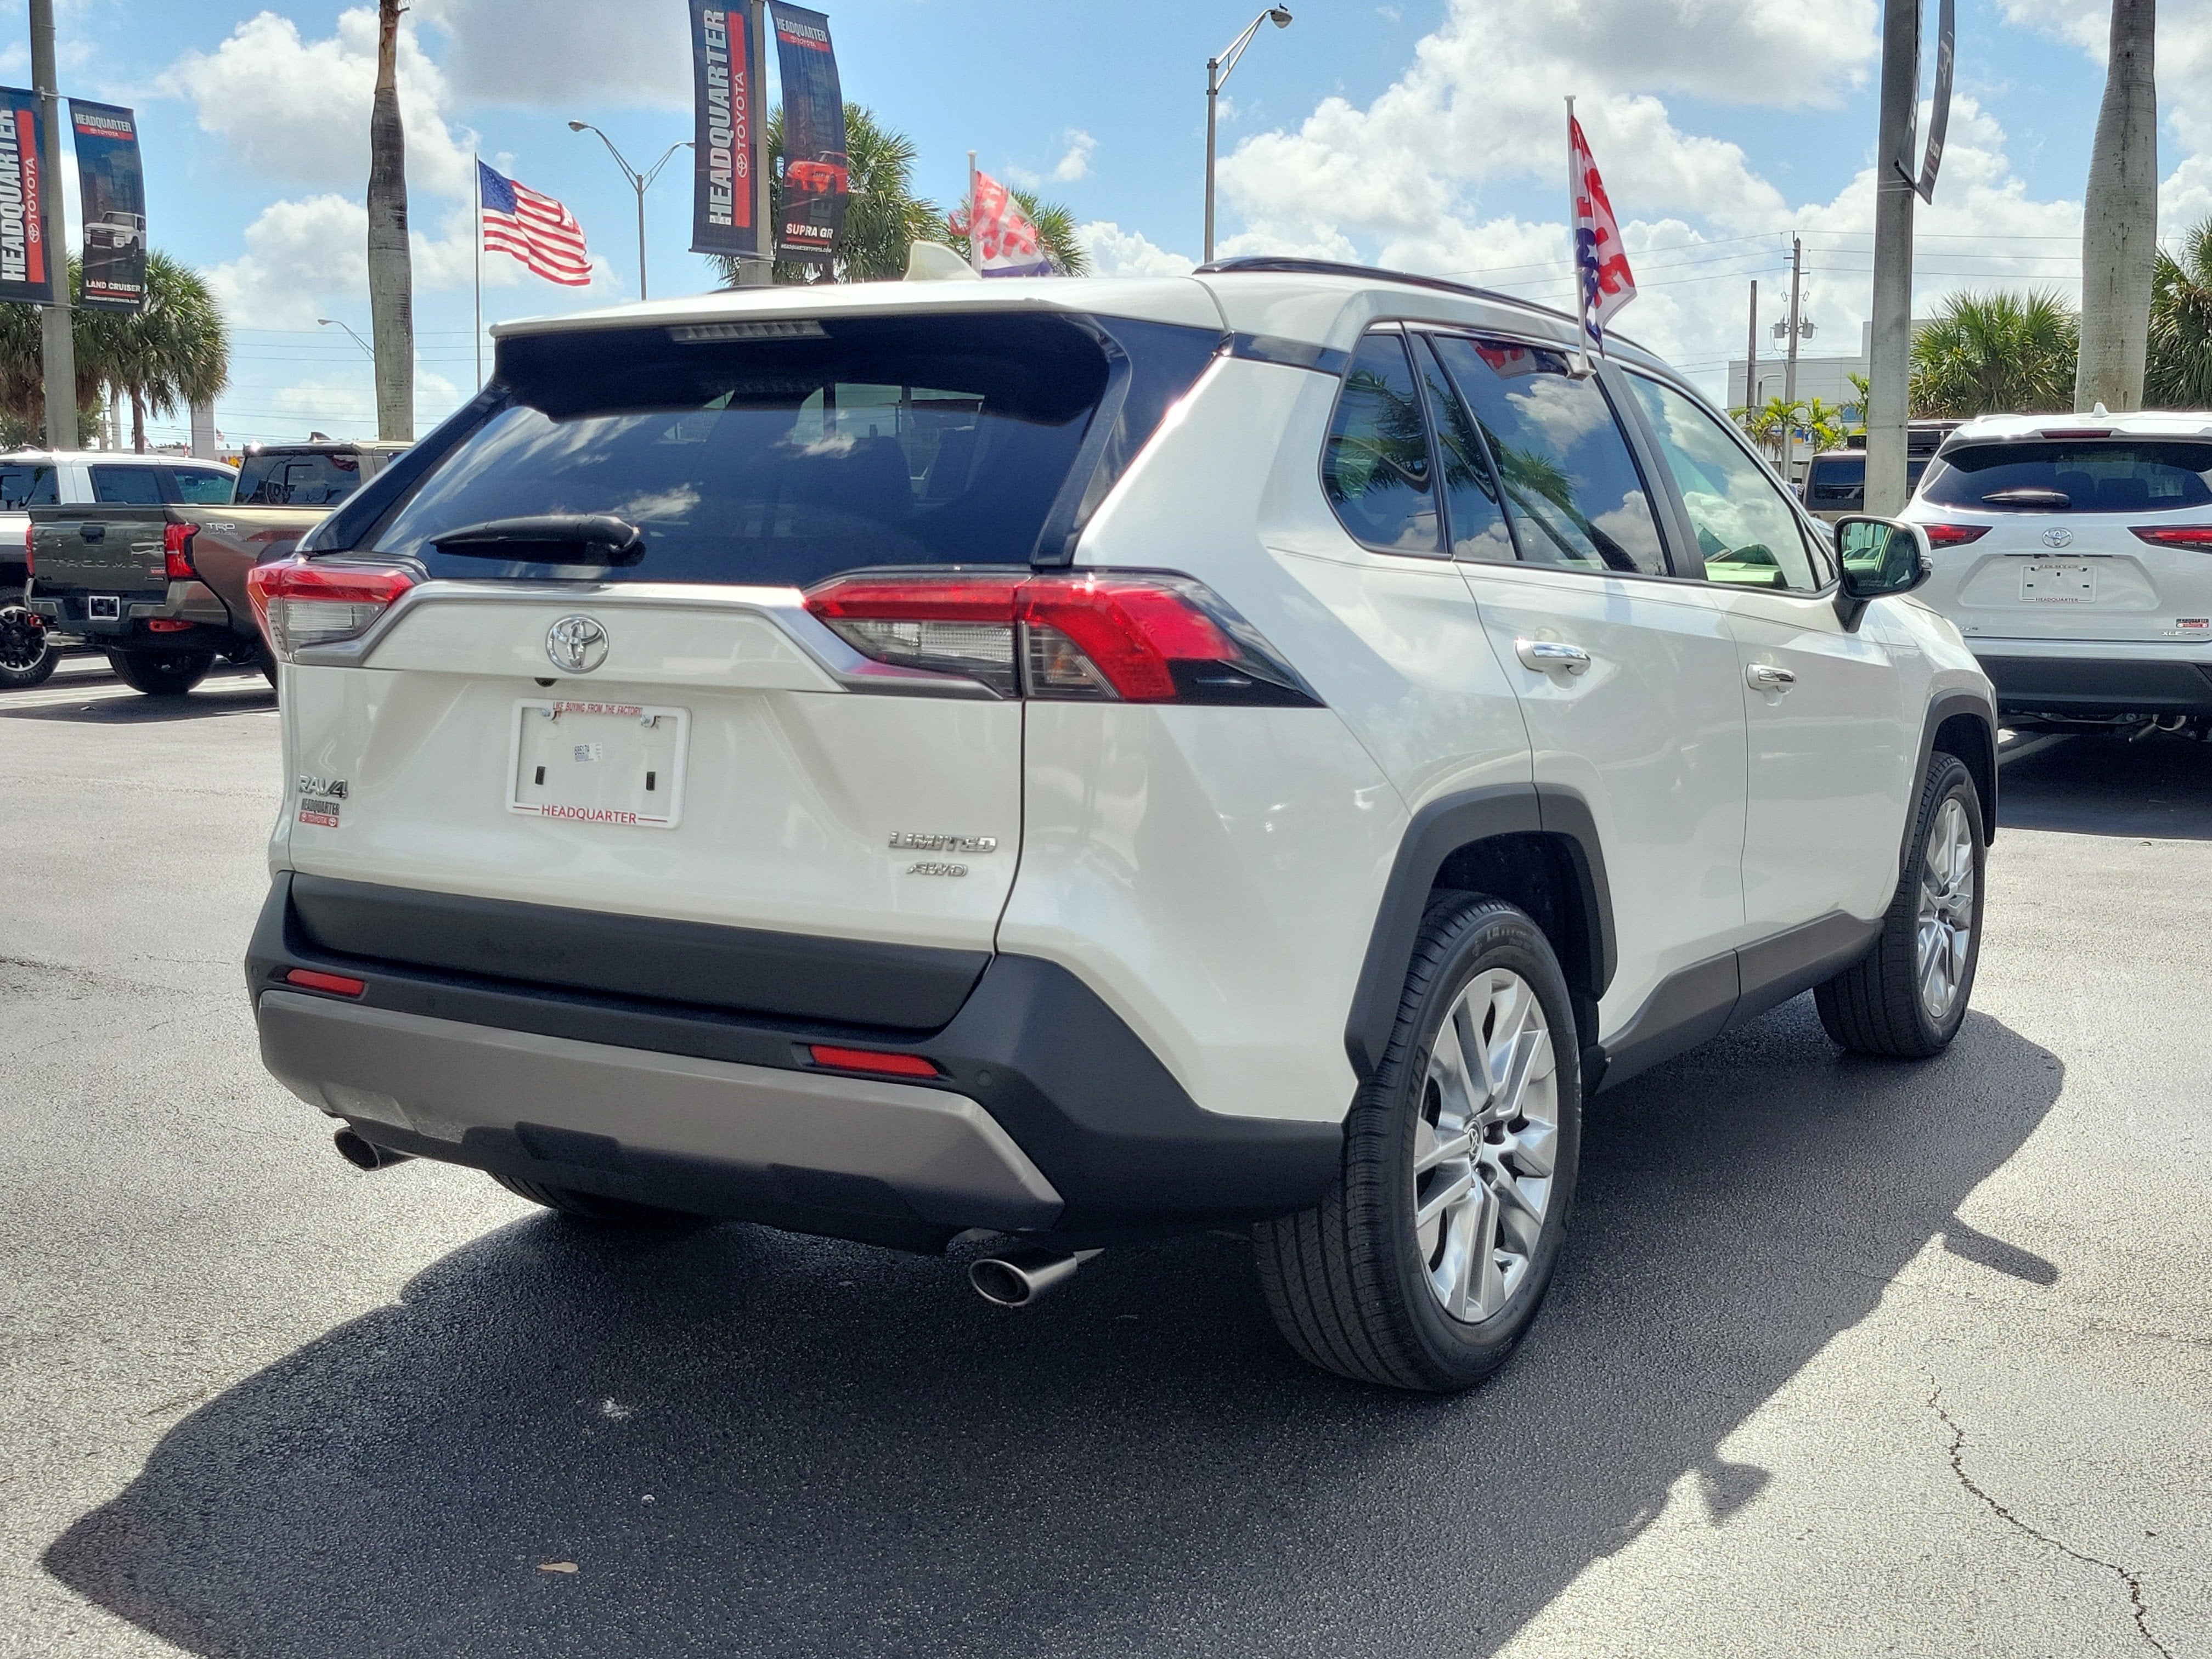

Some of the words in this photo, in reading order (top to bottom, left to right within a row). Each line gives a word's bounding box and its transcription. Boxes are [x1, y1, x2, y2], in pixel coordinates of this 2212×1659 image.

[776, 17, 827, 42] HEADQUARTER
[704, 9, 734, 226] HEADQUARTER
[735, 71, 746, 151] TOYOTA
[75, 113, 132, 132] HEADQUARTER
[98, 129, 119, 137] TOYOTA
[25, 157, 37, 221] TOYOTA
[786, 223, 817, 237] SUPRA
[820, 227, 834, 239] GR
[86, 279, 106, 289] LAND
[108, 283, 142, 292] CRUISER
[205, 522, 235, 531] TRD
[52, 558, 143, 568] TACOMA
[588, 703, 603, 713] FROM
[605, 704, 616, 714] THE
[298, 775, 348, 799] RAV4
[541, 804, 636, 824] HEADQUARTER
[889, 831, 997, 853] LIMITED
[906, 862, 968, 877] AWD
